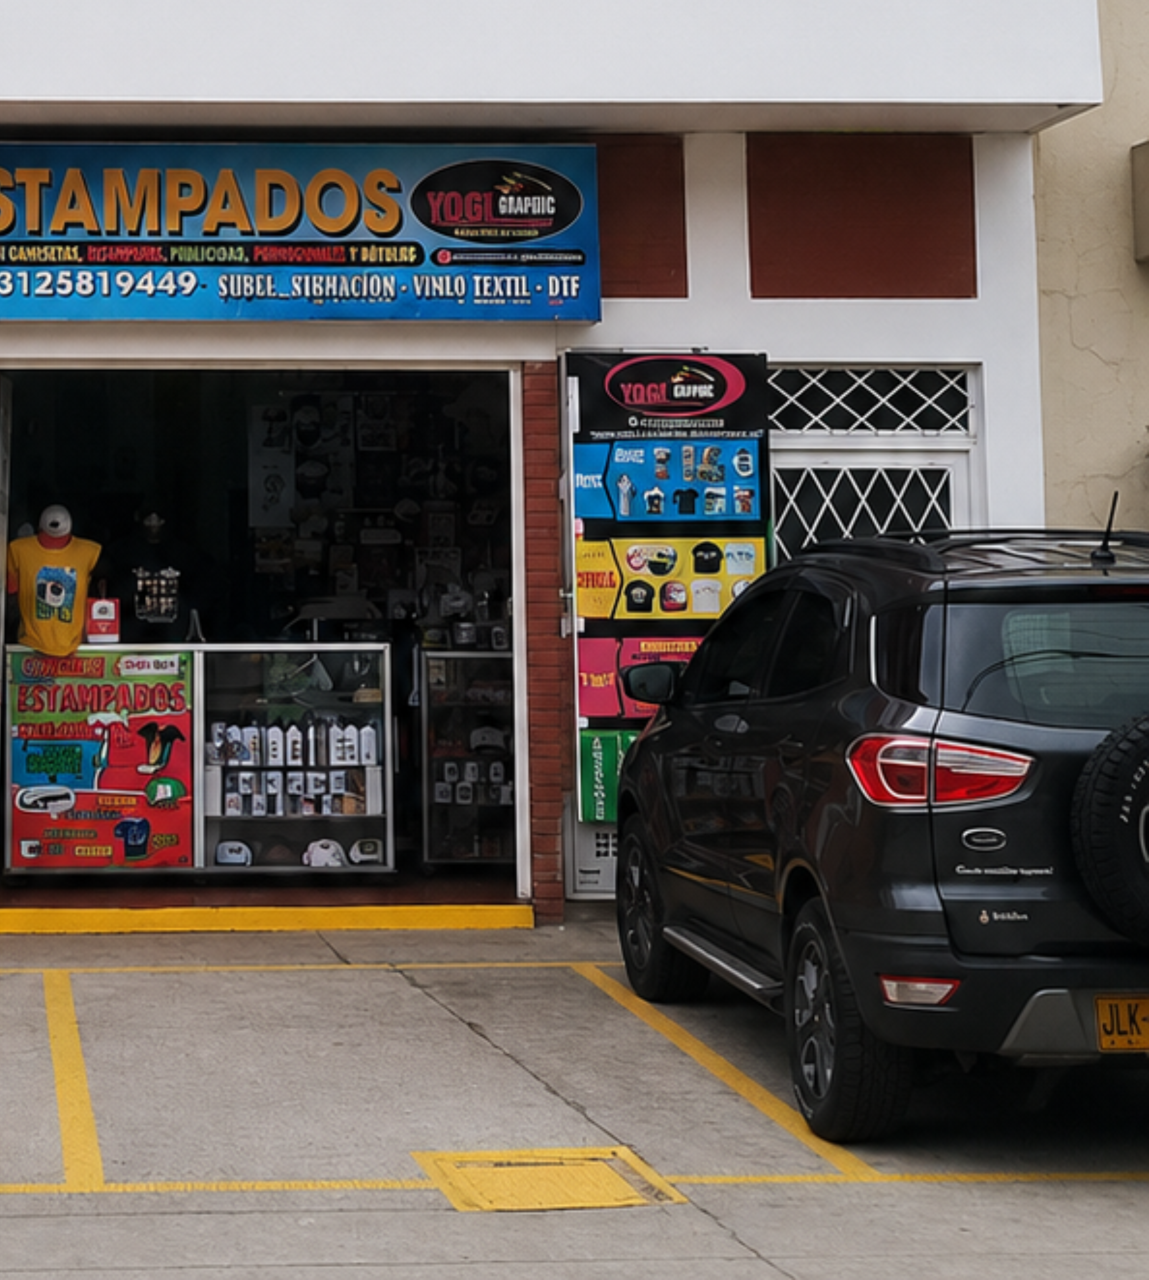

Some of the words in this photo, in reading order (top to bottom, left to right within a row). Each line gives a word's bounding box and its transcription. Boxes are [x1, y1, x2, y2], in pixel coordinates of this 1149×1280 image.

[426, 191, 494, 225] YOGI
[473, 275, 531, 297] TEXTIL
[548, 276, 580, 297] DTF
[17, 682, 186, 713] ESTAMPADOS
